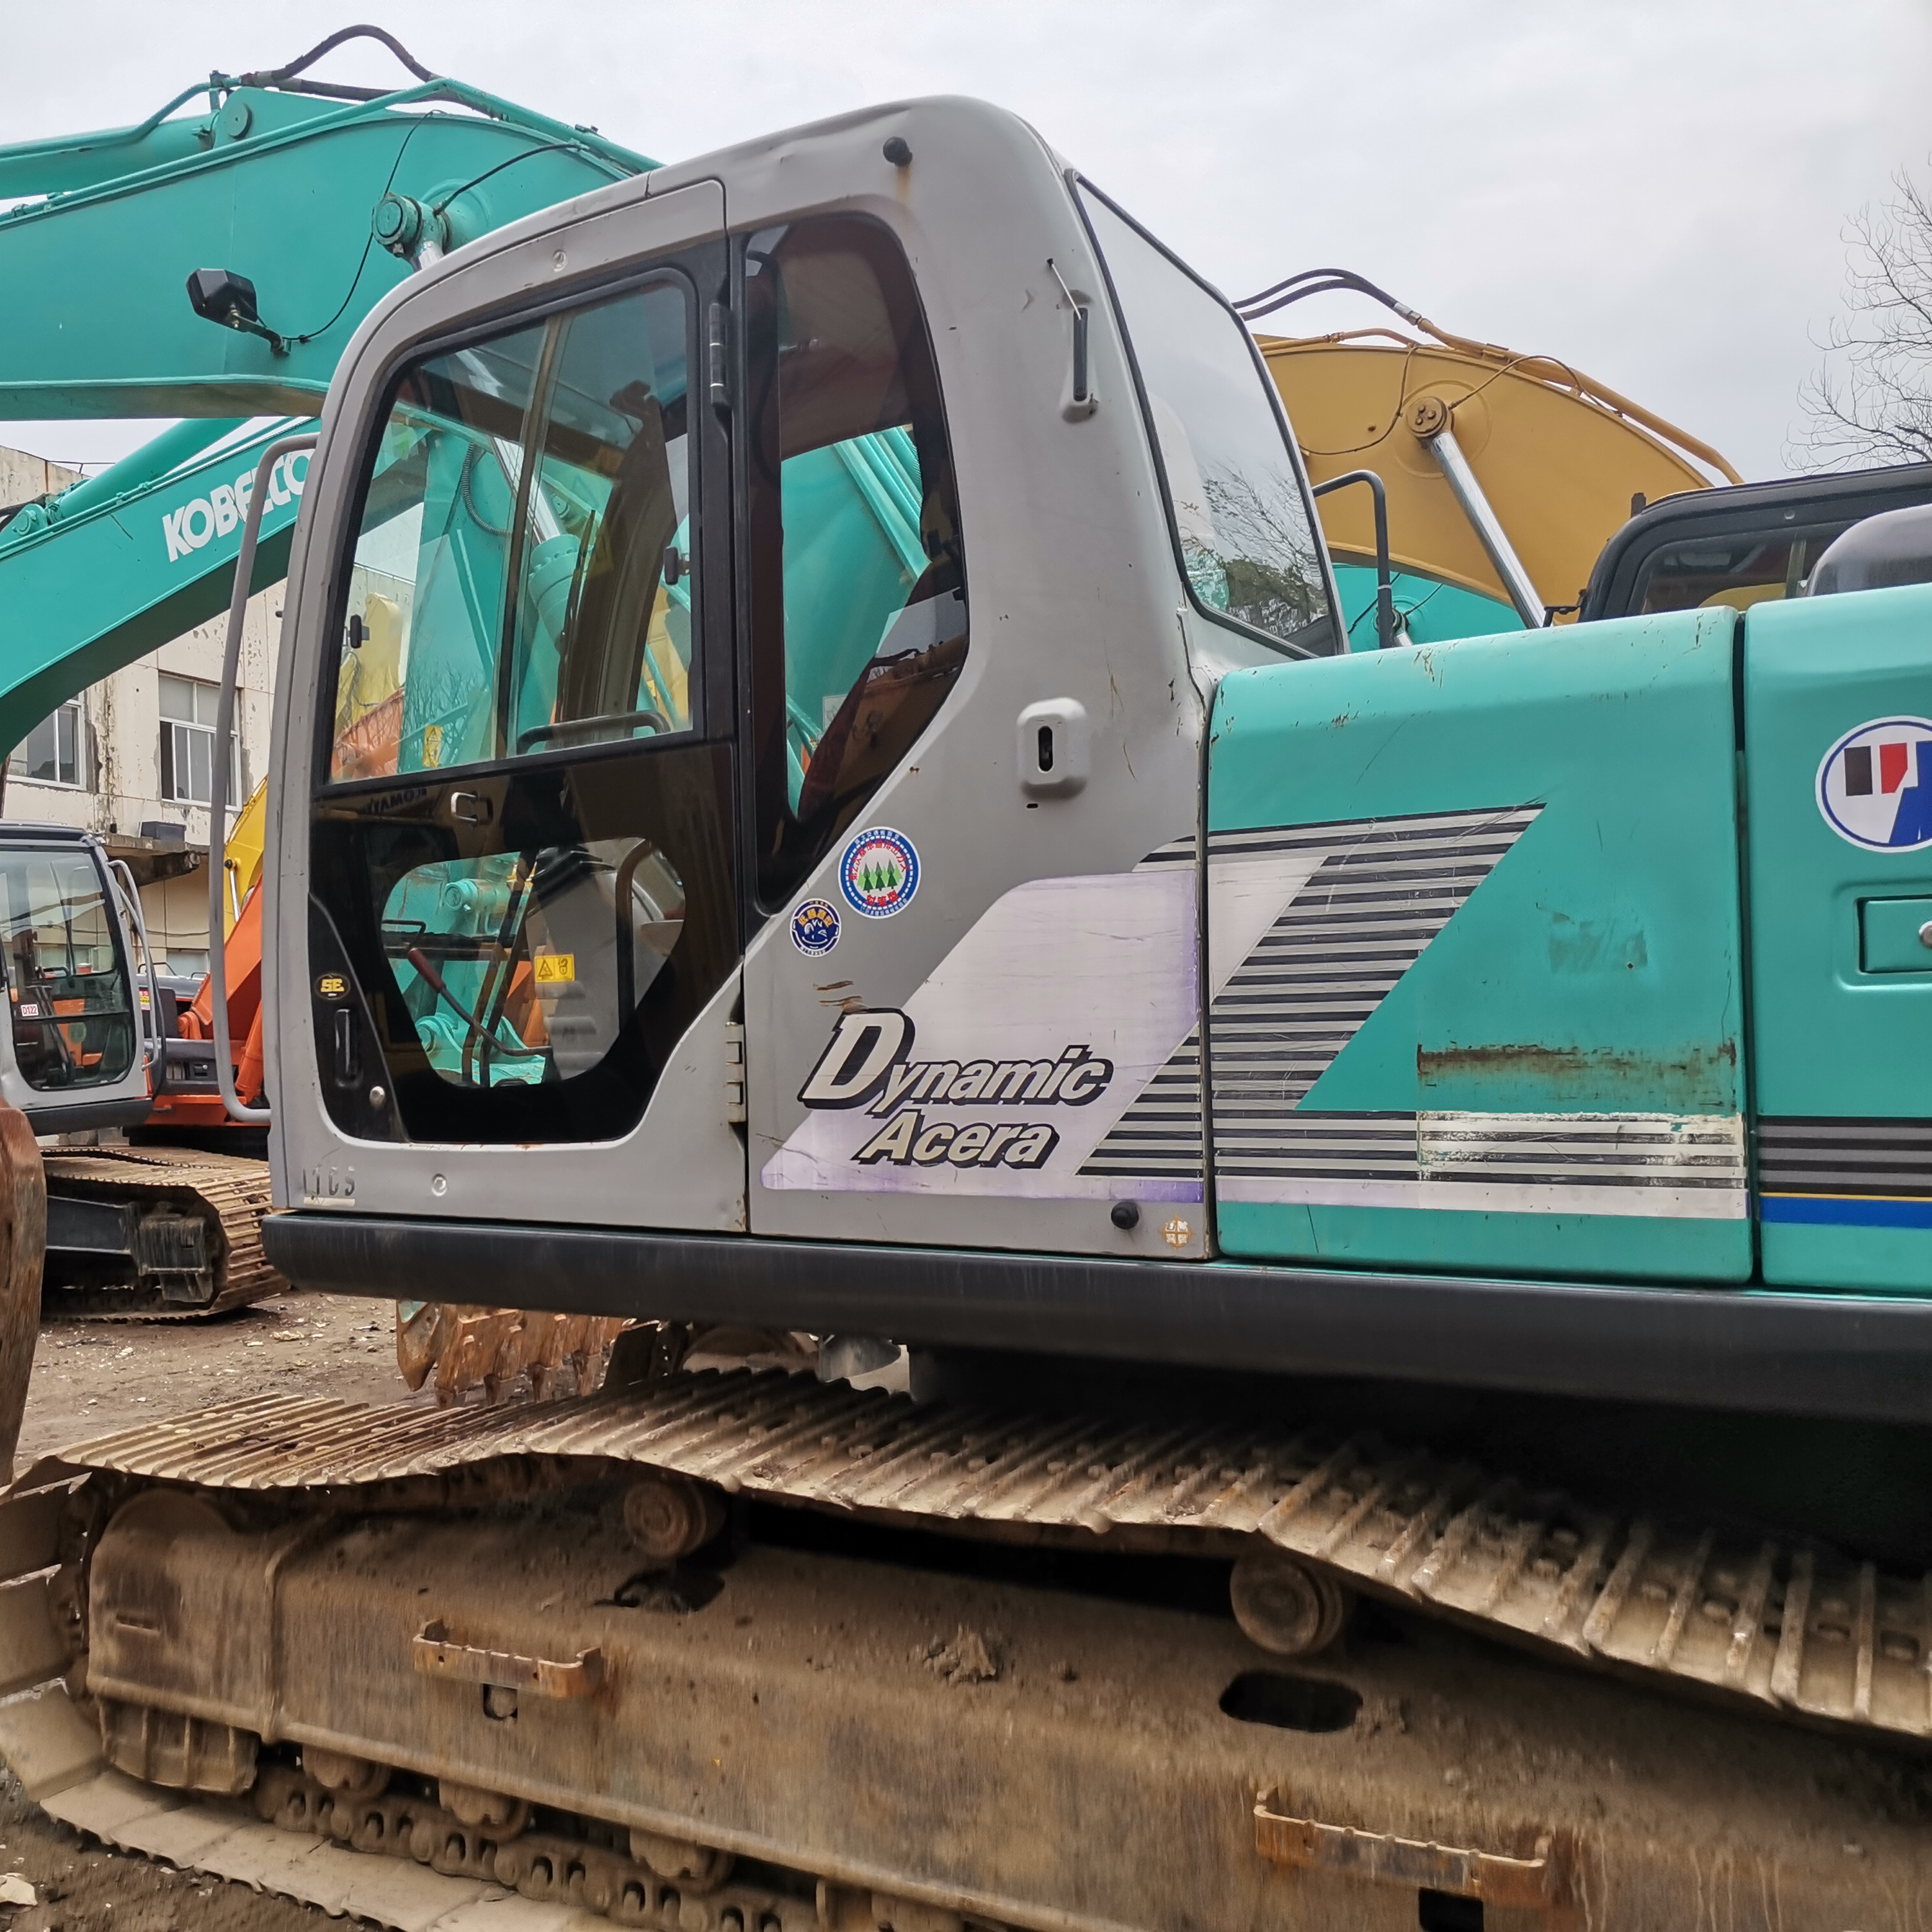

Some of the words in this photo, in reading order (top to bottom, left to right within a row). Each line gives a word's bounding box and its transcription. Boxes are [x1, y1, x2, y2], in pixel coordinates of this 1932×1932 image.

[22, 1006, 37, 1015] D122
[797, 1007, 1114, 1119] Dynamic
[849, 1108, 1060, 1170] Acera
